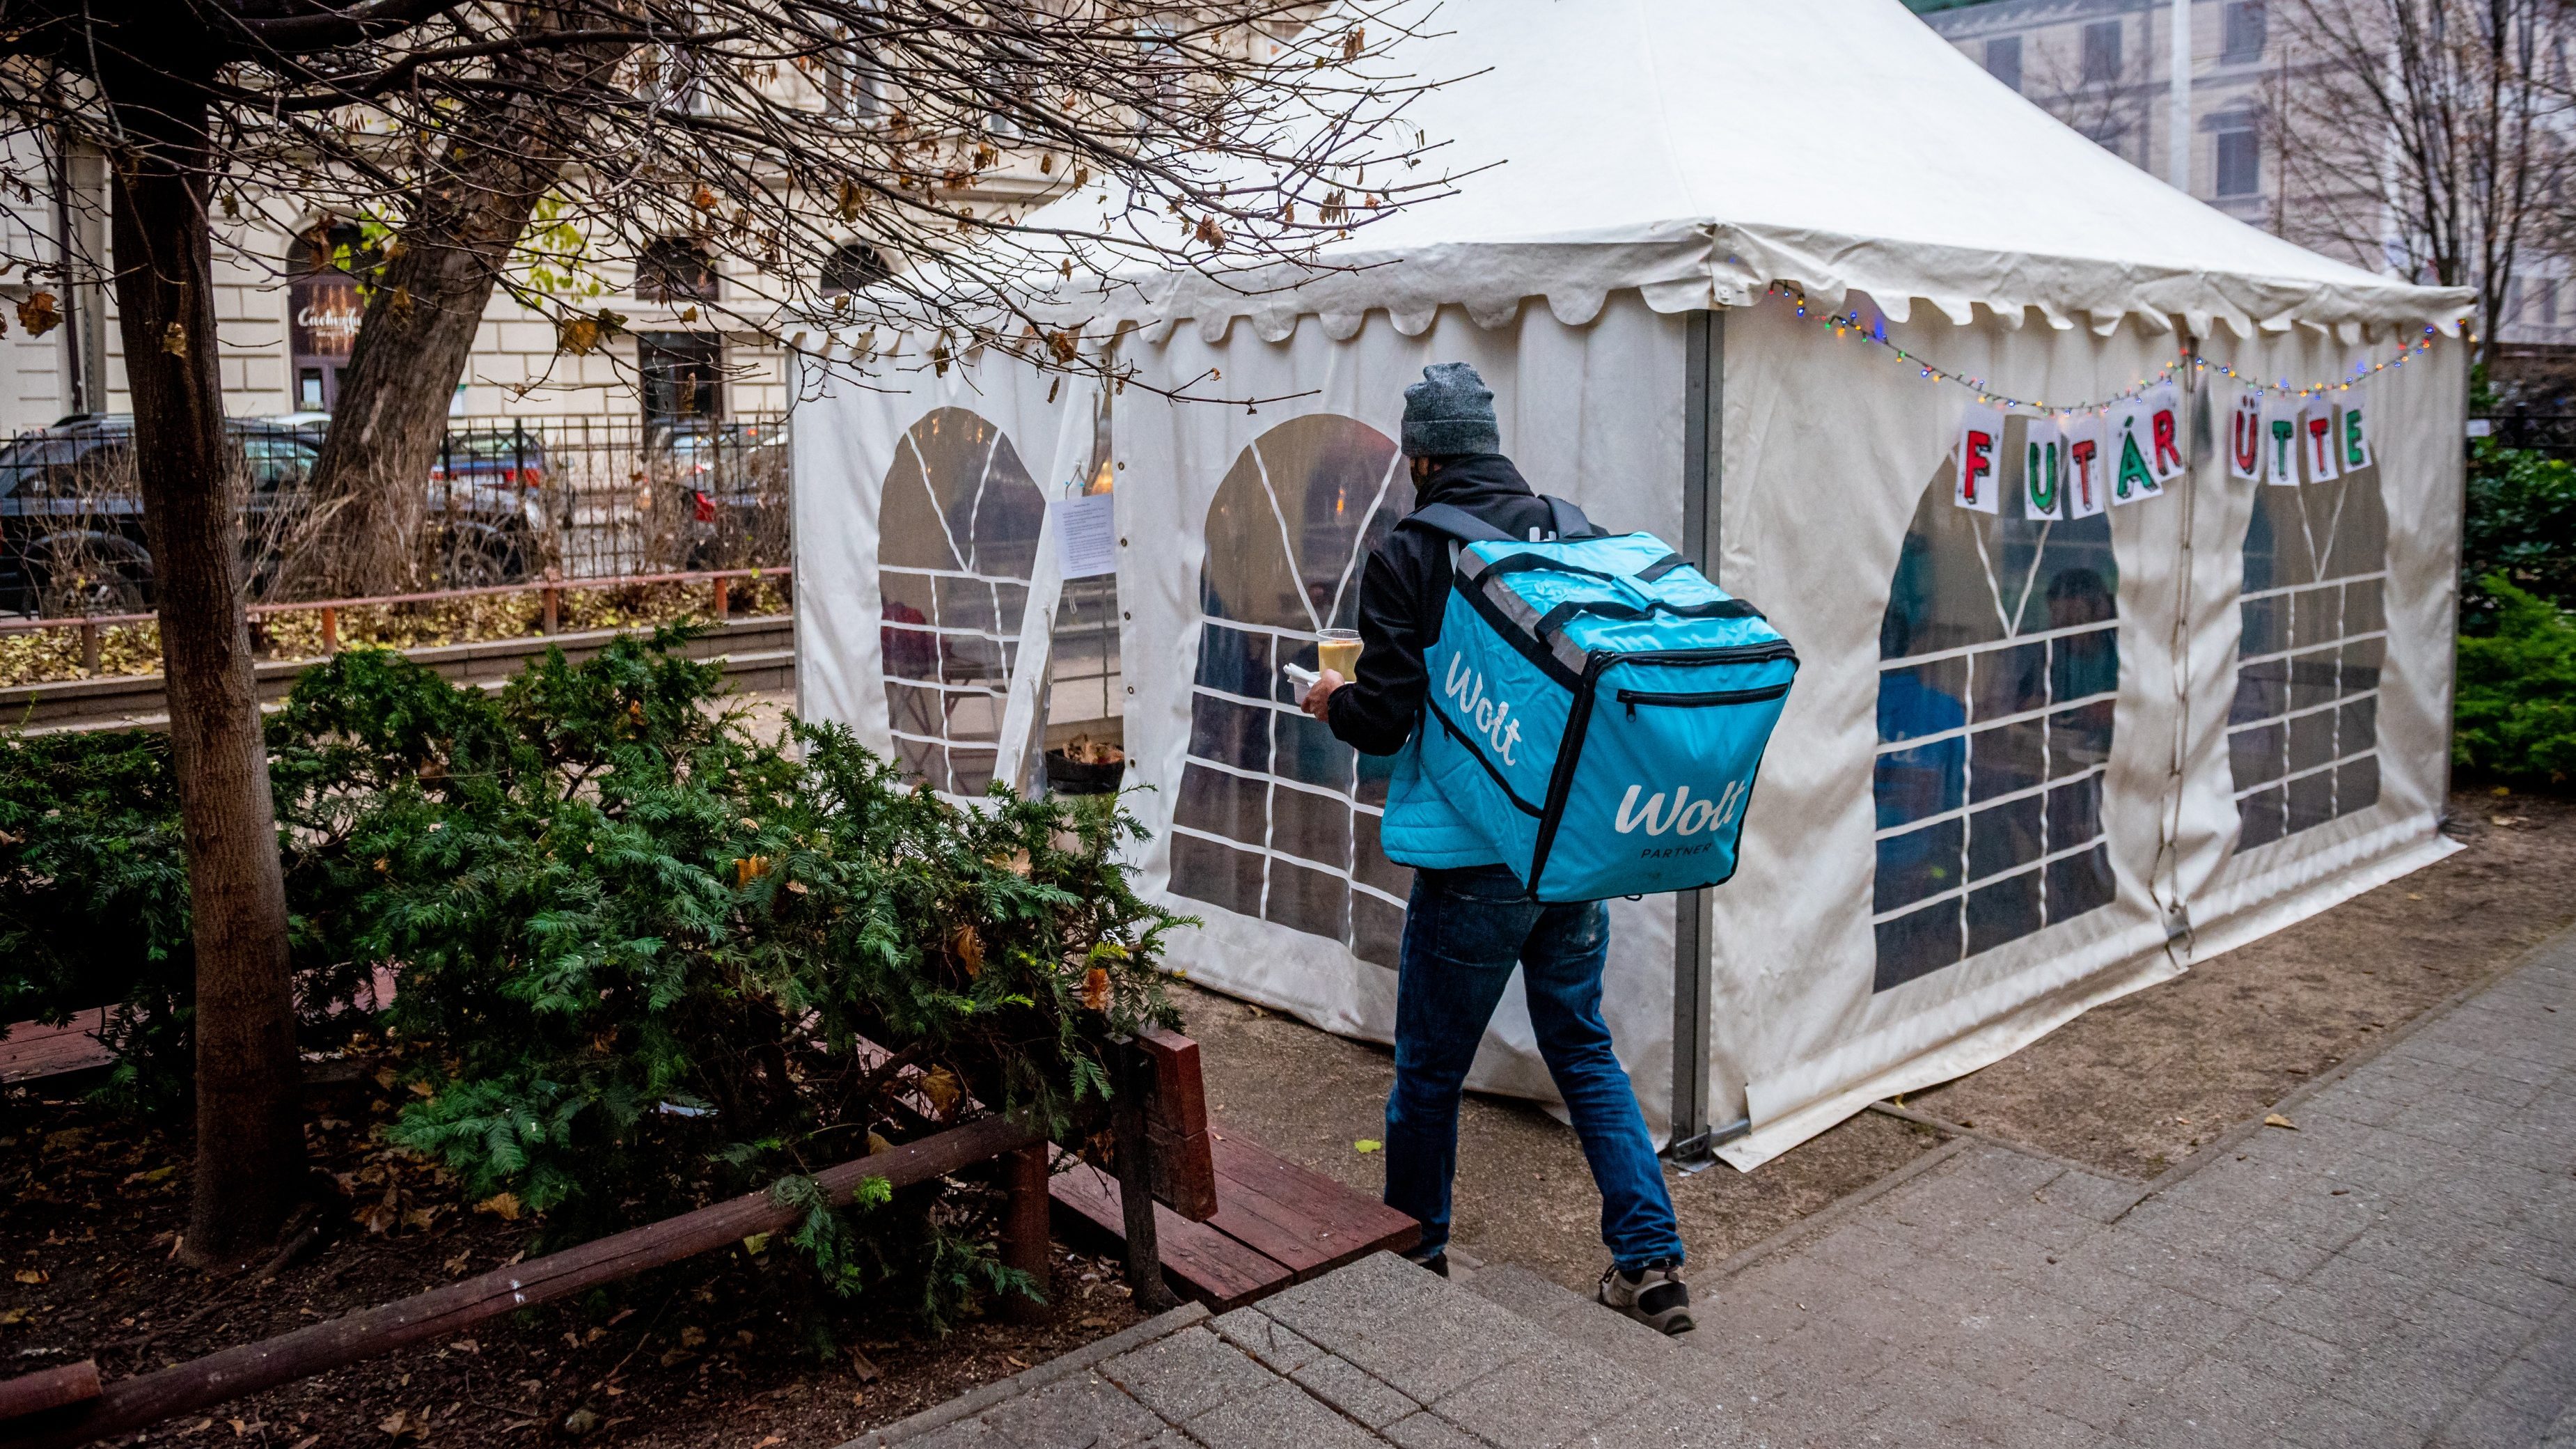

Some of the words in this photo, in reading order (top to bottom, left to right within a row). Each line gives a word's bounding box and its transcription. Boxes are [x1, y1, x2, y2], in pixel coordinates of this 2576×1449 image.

[1963, 409, 2183, 515] FUTÁR
[2236, 395, 2365, 481] ÜTTE
[1445, 651, 1523, 766] Wolt
[1615, 779, 1746, 836] Wolt
[1640, 843, 1713, 859] PARTNER
